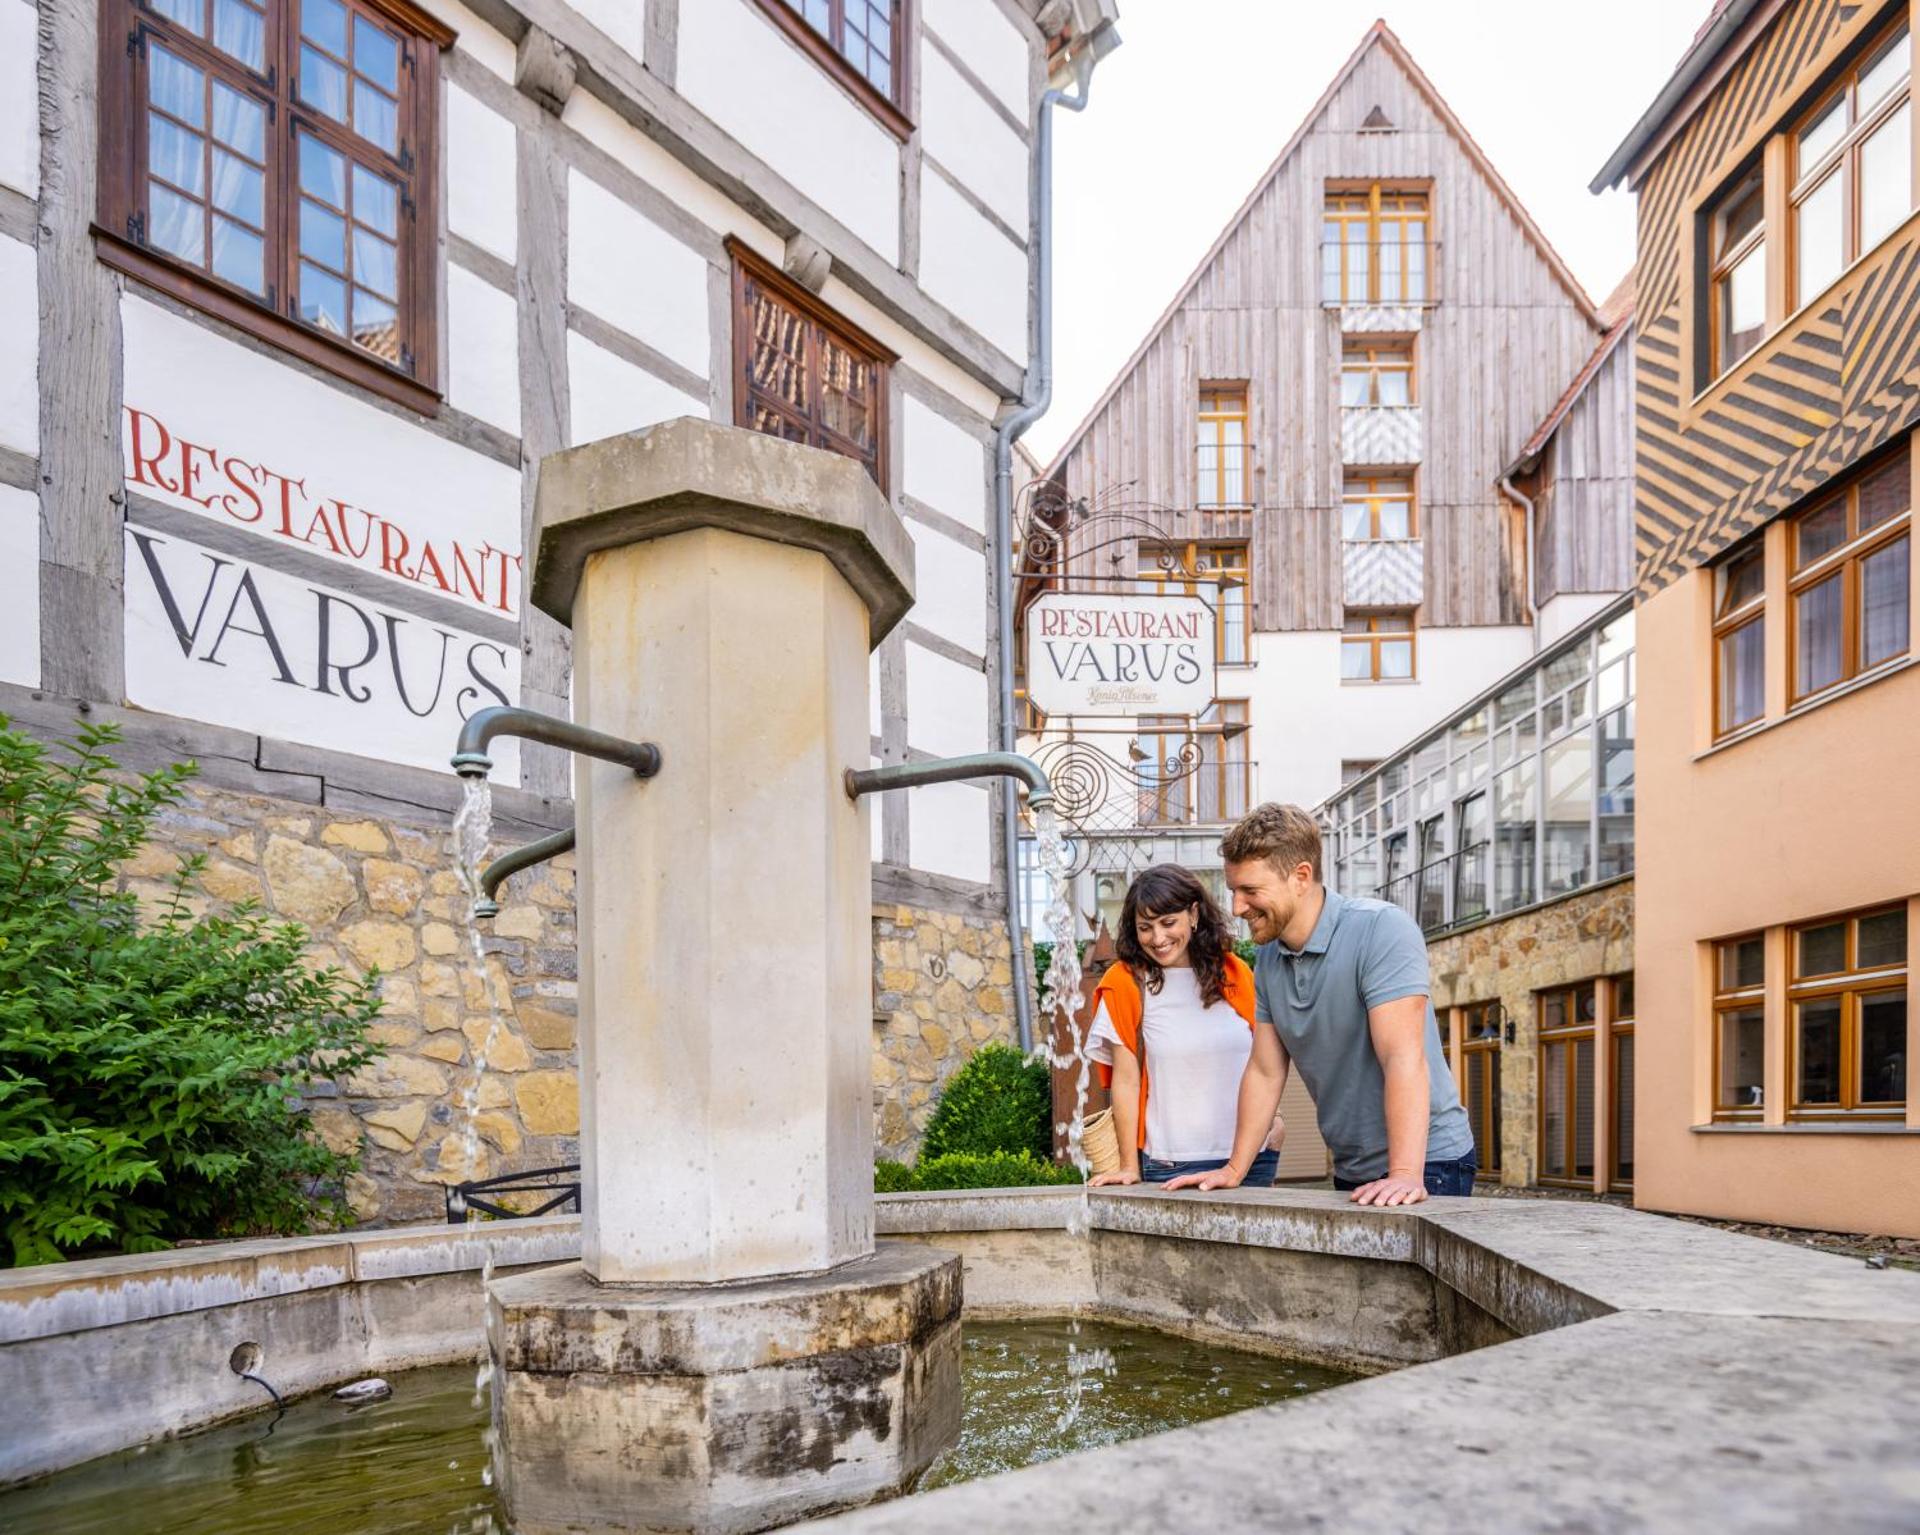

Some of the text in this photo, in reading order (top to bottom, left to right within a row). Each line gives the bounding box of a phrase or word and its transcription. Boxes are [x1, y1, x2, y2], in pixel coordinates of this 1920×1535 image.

[123, 405, 521, 613] RESTAURANT
[126, 530, 511, 722] VARUS
[1040, 608, 1203, 639] RESTAURANT
[1043, 641, 1200, 684] VARUS
